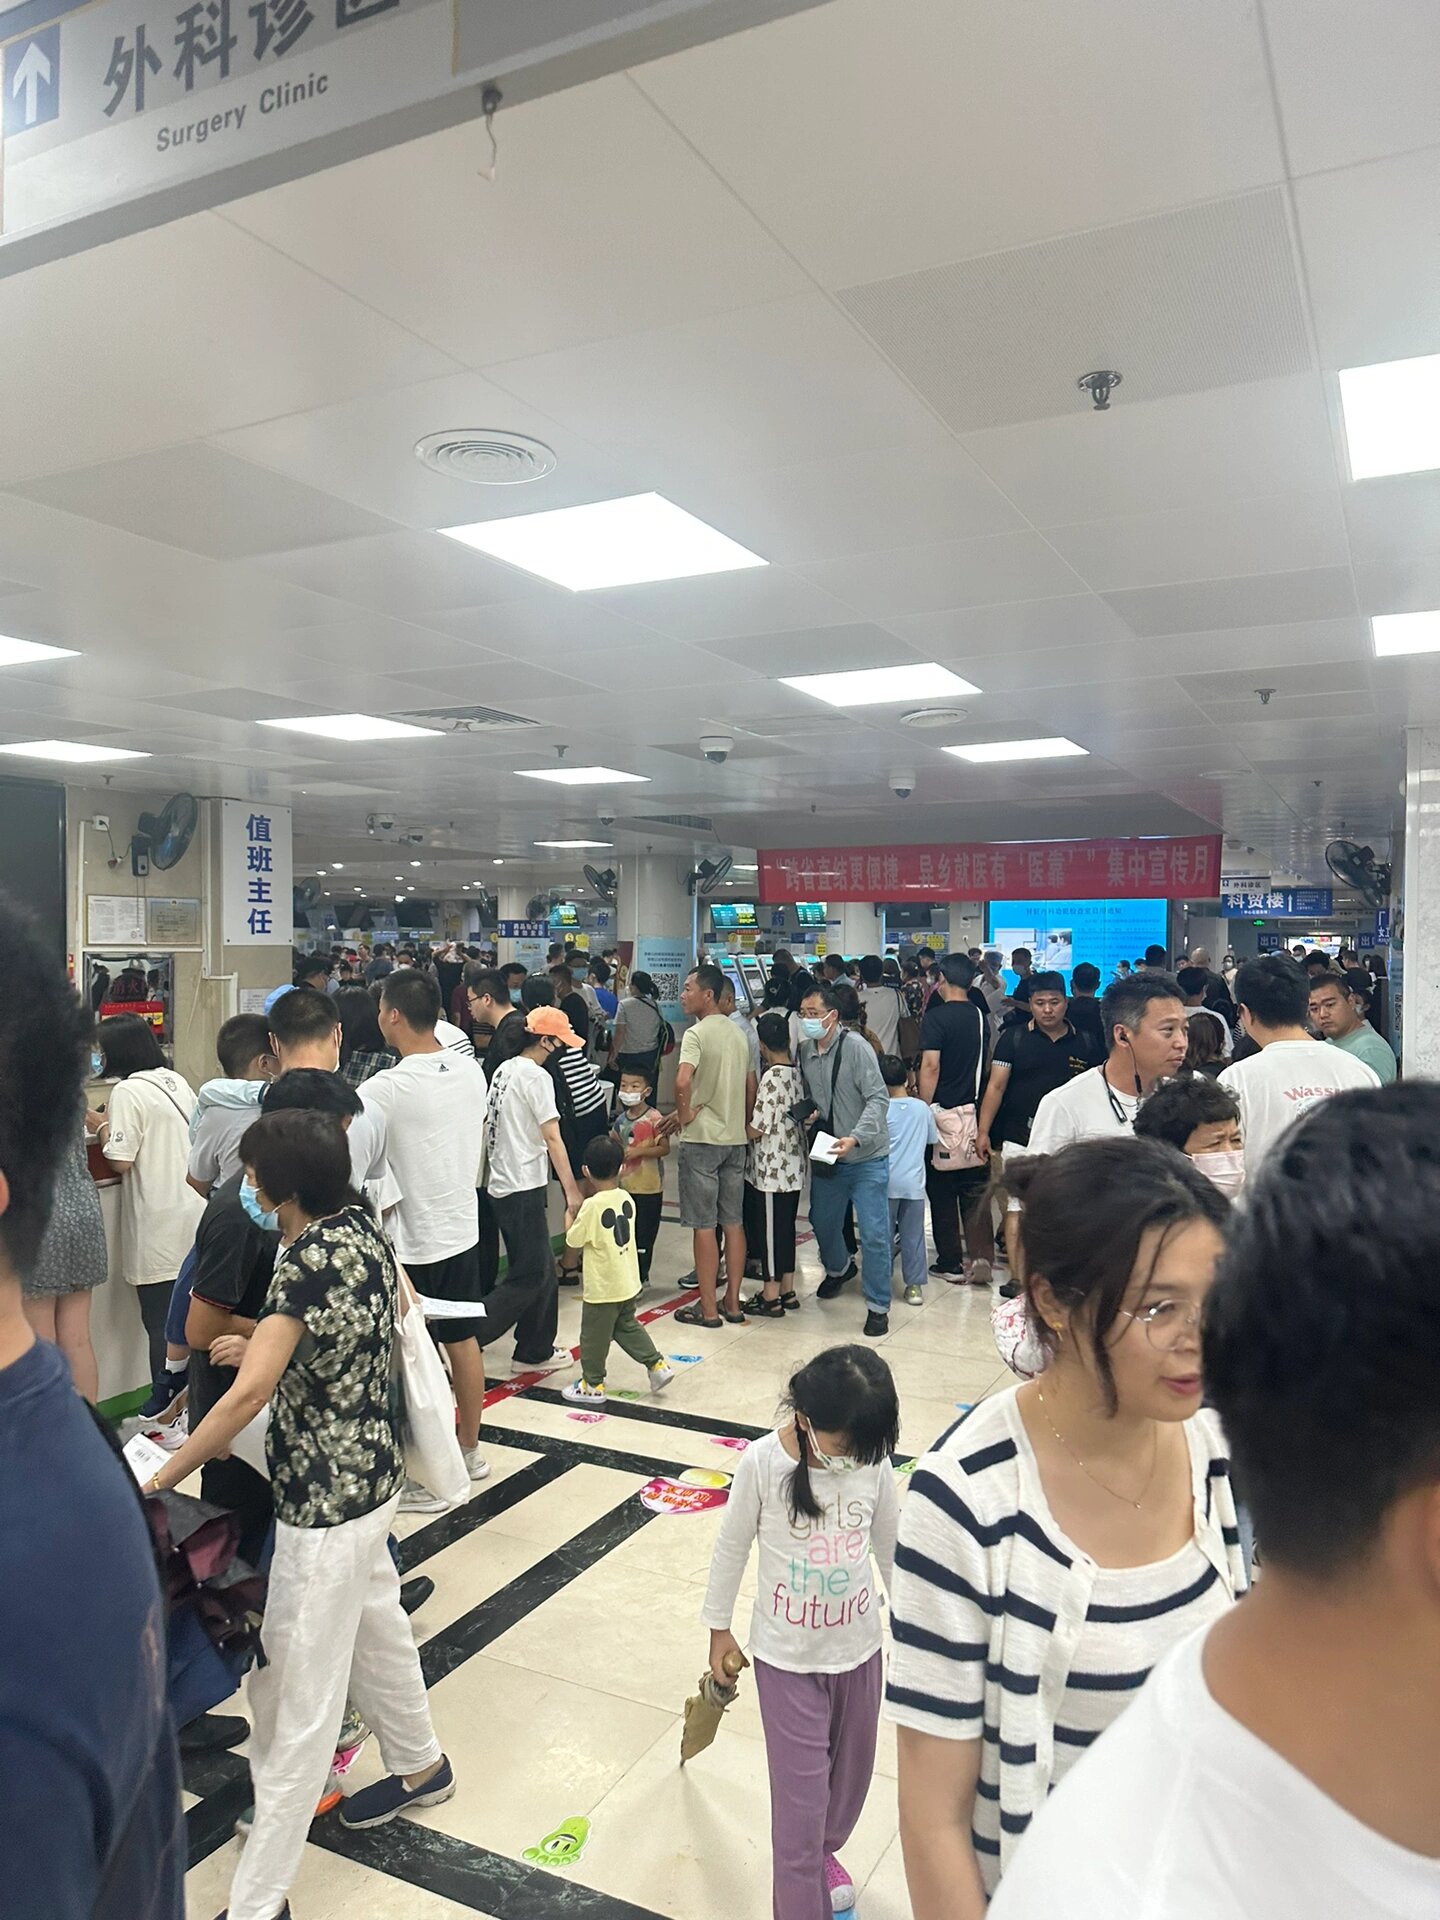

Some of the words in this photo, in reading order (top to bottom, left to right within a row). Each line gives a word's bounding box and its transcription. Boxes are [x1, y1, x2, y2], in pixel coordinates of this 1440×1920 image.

[156, 104, 247, 152] Surgery
[259, 73, 329, 115] Clinic
[245, 813, 273, 935] 值班主任
[1227, 893, 1284, 909] 科贸楼
[1260, 935, 1278, 946] 出口
[808, 1530, 863, 1565] are
[788, 1556, 850, 1596] the
[773, 1583, 870, 1630] future
